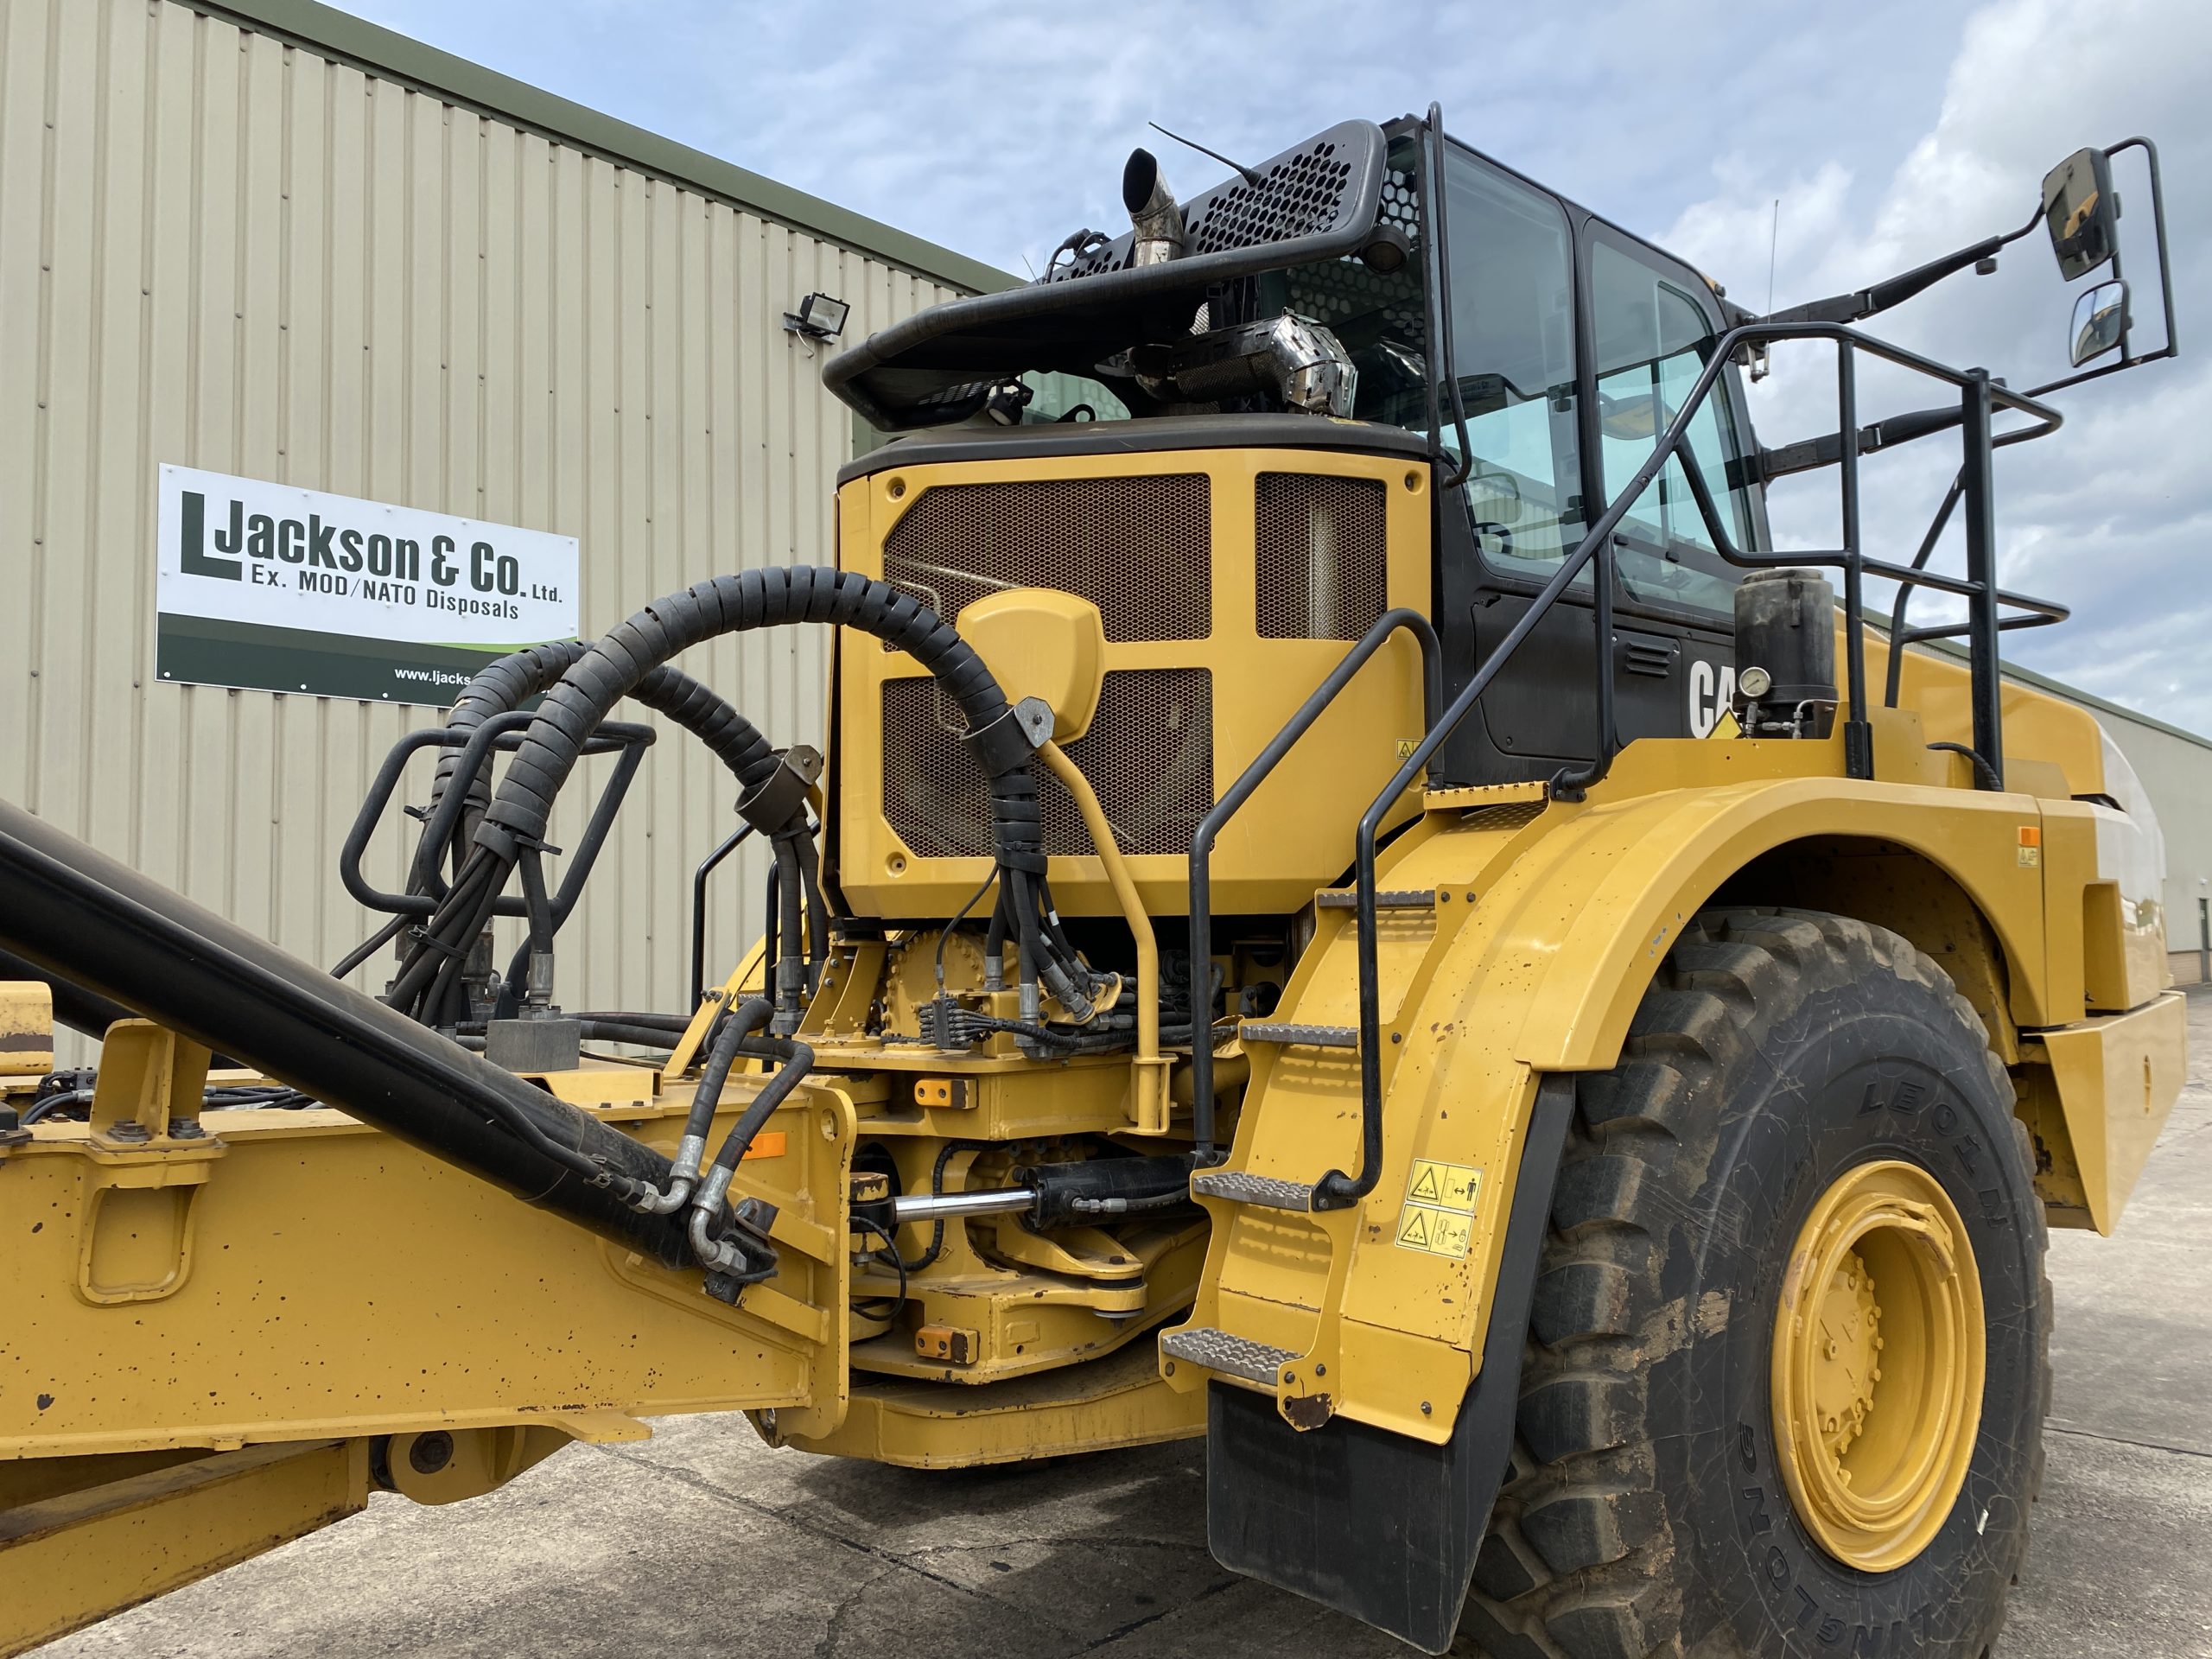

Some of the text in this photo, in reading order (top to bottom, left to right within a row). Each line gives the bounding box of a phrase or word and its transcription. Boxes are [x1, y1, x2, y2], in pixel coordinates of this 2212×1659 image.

[251, 563, 519, 620] Ex. MOD/NATO Disposals
[430, 534, 460, 587] &
[470, 541, 527, 598] Co.
[531, 582, 563, 604] Ltd.
[394, 668, 472, 686] www.ljacks
[1689, 659, 1738, 740] CA
